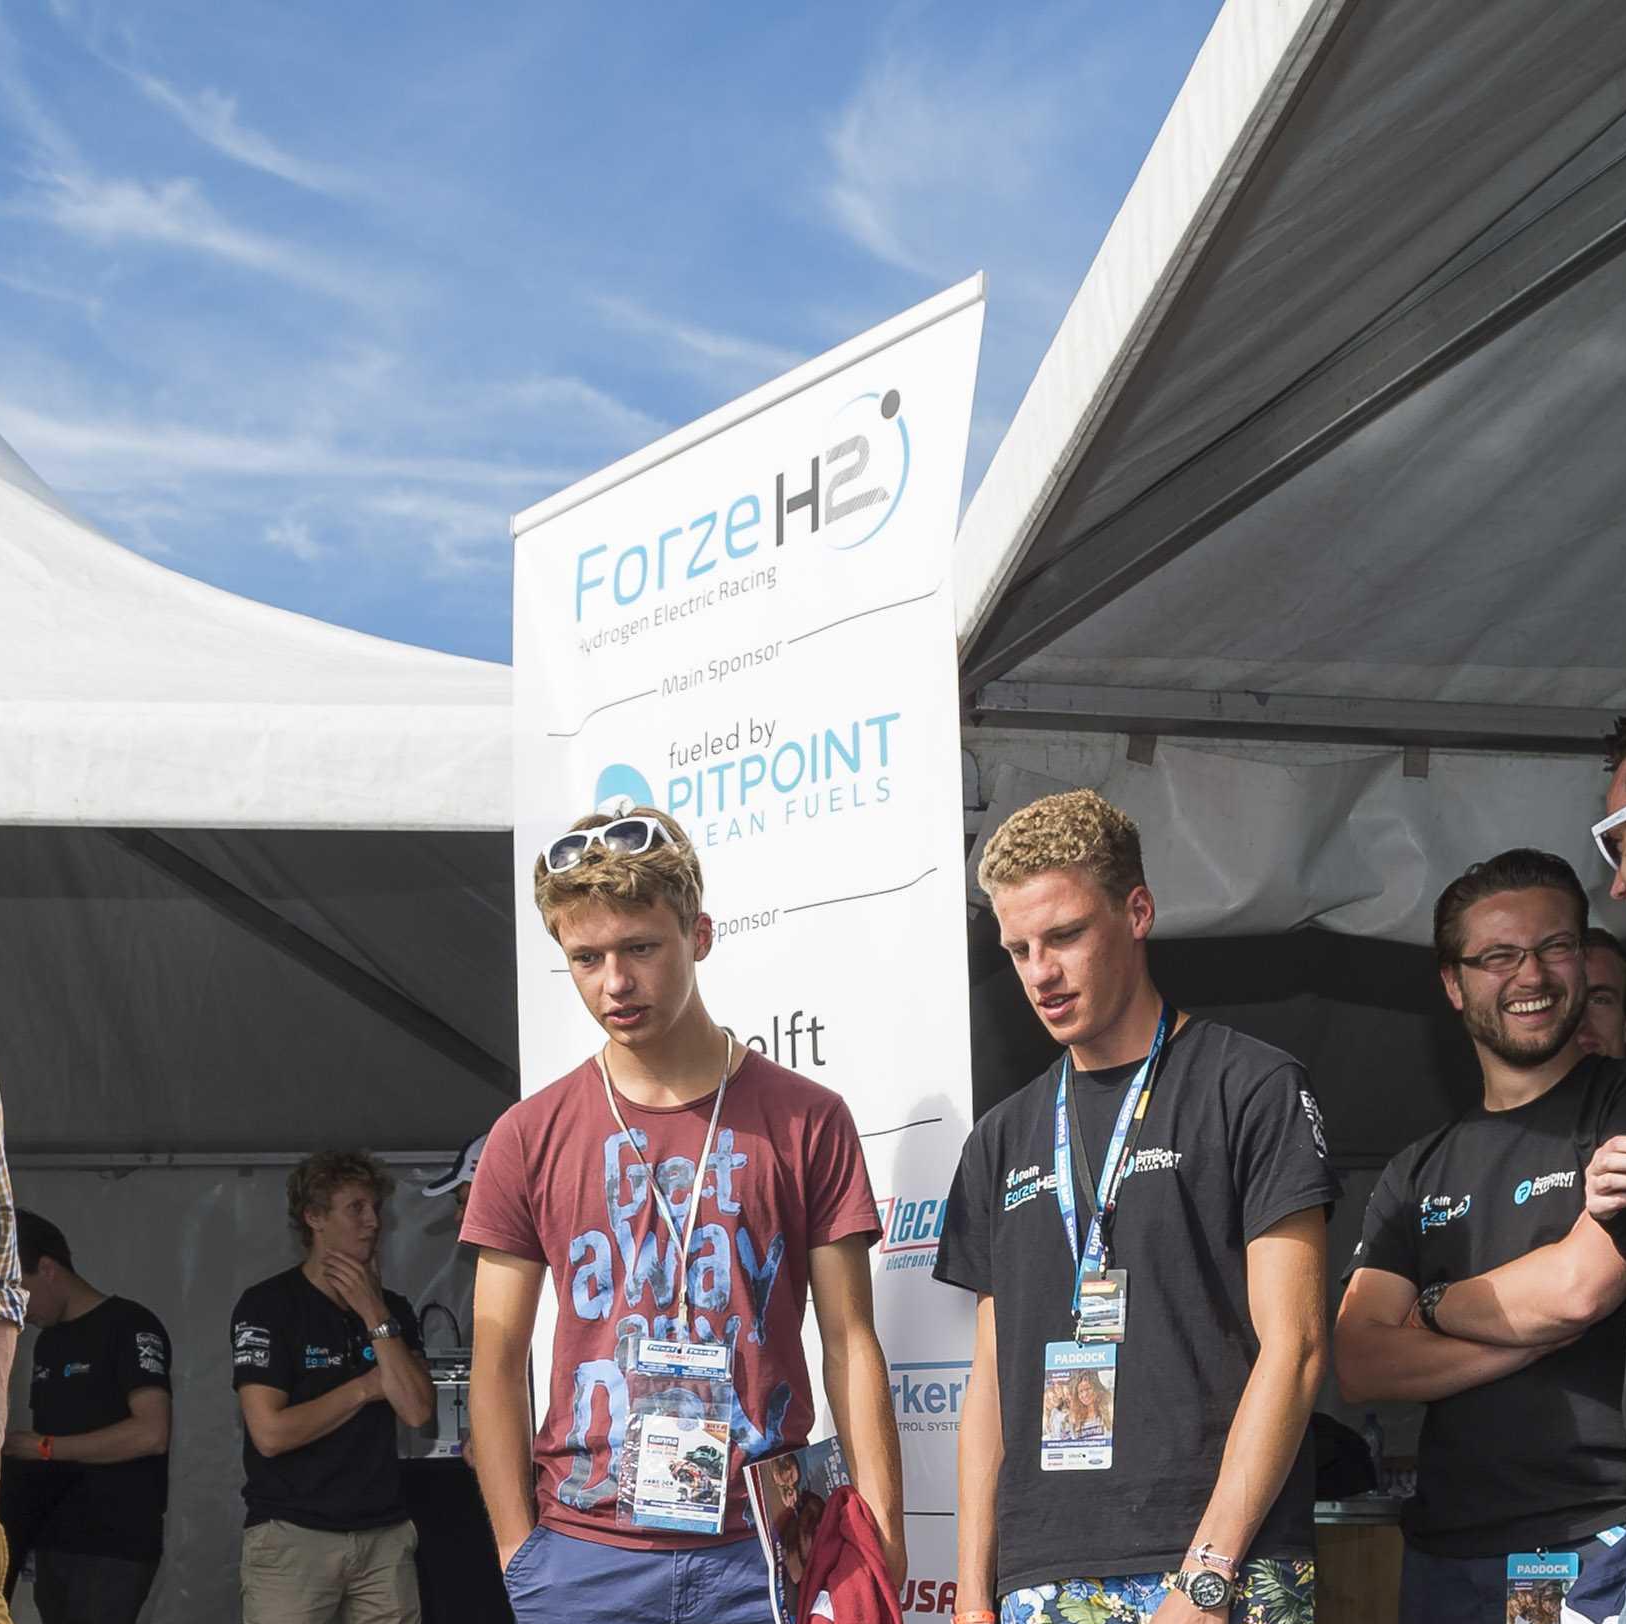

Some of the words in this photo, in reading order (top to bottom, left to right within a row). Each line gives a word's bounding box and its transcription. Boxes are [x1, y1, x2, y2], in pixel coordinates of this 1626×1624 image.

[654, 590, 714, 628] Electric
[719, 566, 778, 602] Racing
[662, 668, 704, 697] Main
[708, 640, 783, 683] Sponsor
[668, 711, 901, 818] PITPOINT
[669, 721, 740, 769] fueled
[750, 718, 777, 748] by
[687, 809, 766, 851] LEAN
[785, 776, 891, 825] FUELS
[720, 1010, 826, 1069] elft
[603, 1127, 748, 1226] Get
[569, 1222, 786, 1345] away
[1054, 1351, 1106, 1365] PADDOCK
[898, 1422, 925, 1432] TROL
[927, 1421, 960, 1432] SYSTE
[1516, 1564, 1570, 1575] PADDOCK
